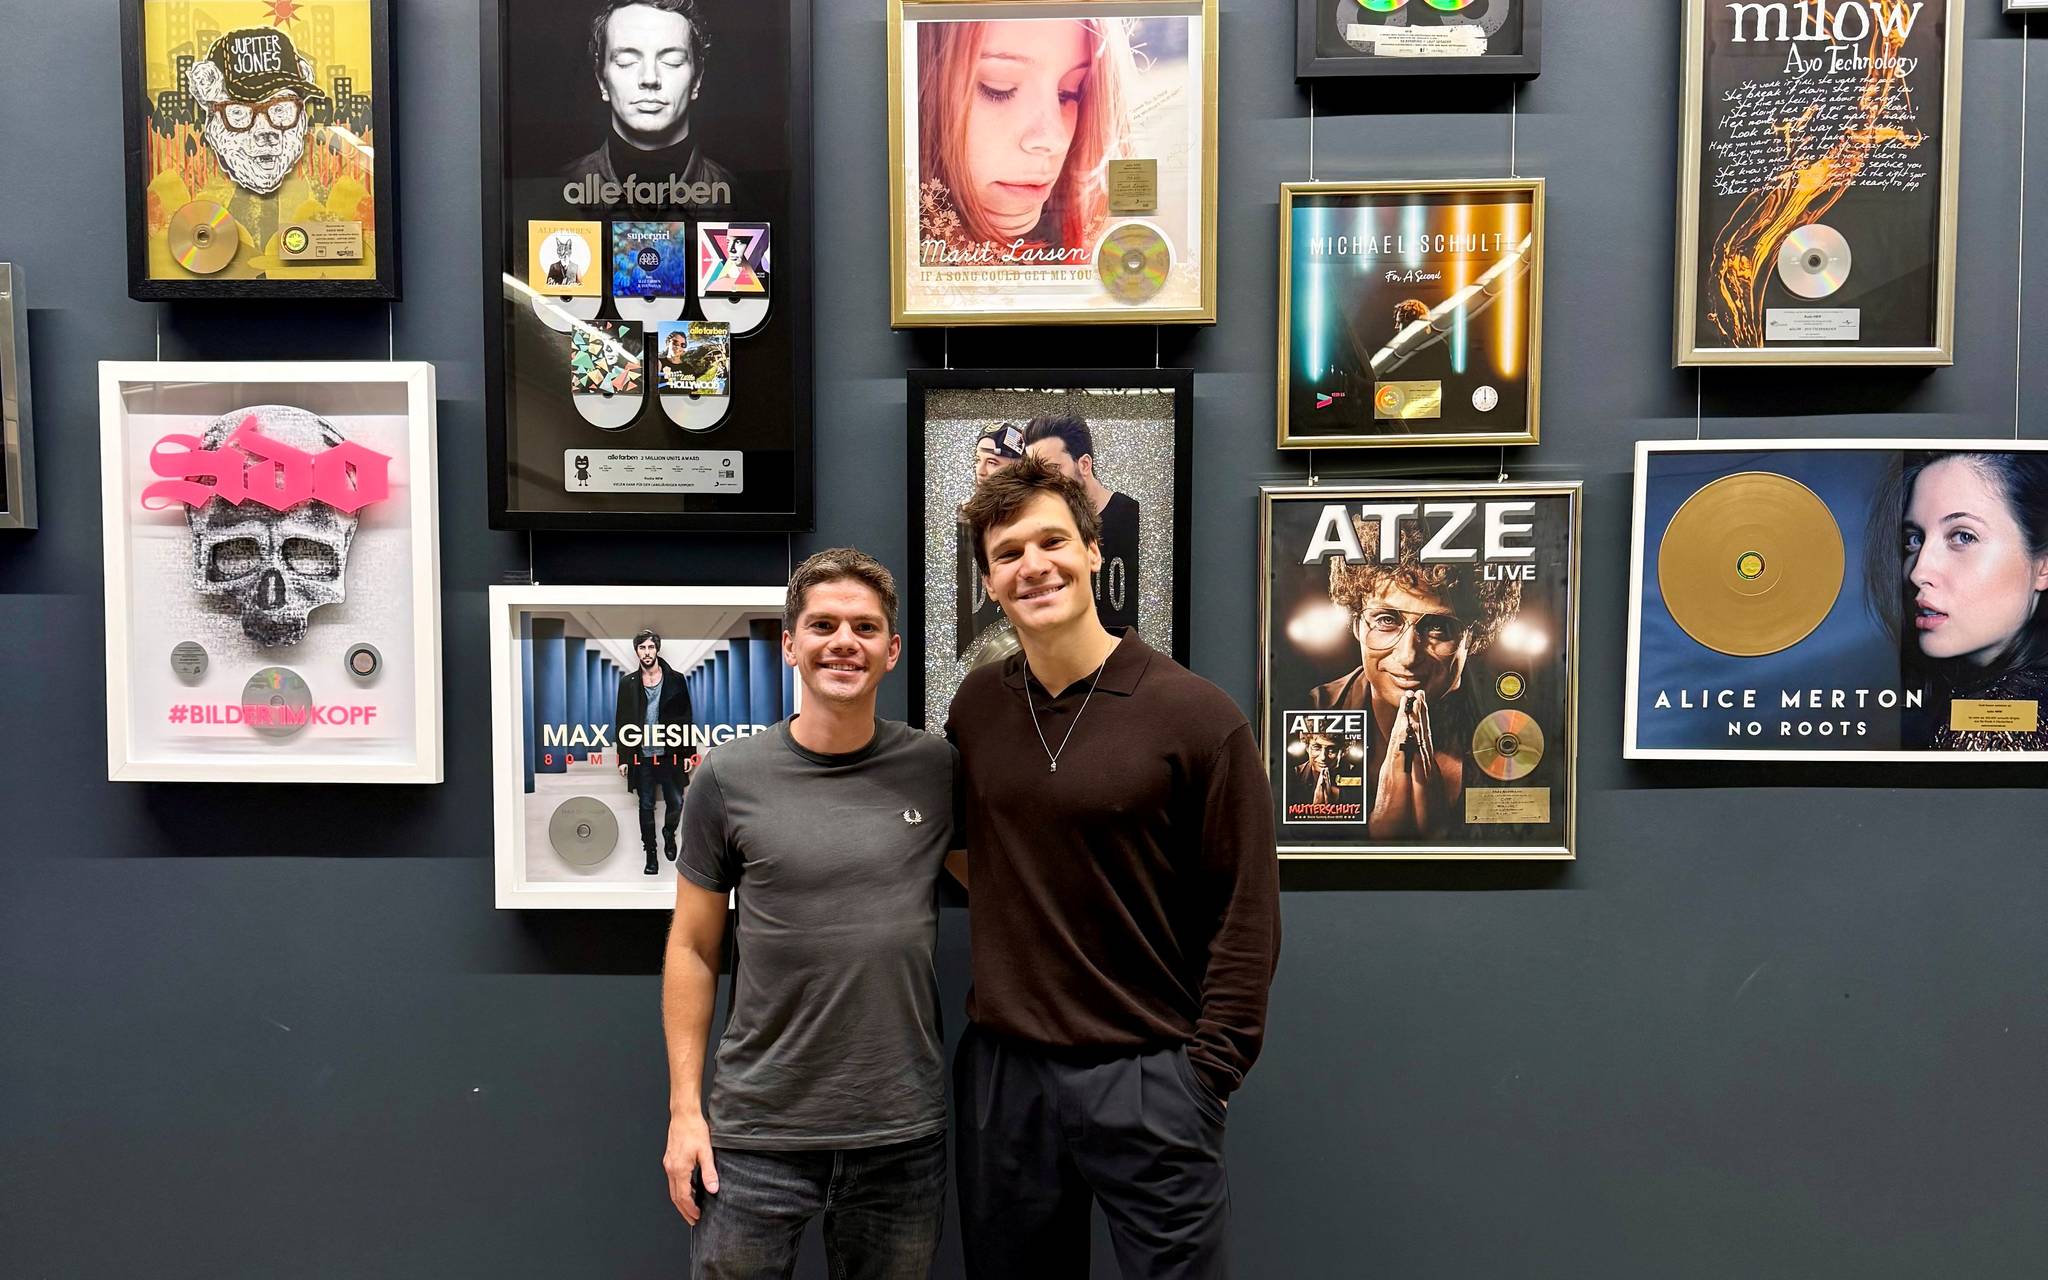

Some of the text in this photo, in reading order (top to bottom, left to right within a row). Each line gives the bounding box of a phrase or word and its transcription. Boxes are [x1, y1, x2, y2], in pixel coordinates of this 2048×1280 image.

[1726, 0, 1923, 42] milow
[231, 36, 280, 54] JUPITER
[234, 53, 280, 74] JONES
[1784, 42, 1918, 79] Ayo Technology
[626, 230, 670, 242] supergirl
[1310, 234, 1404, 256] MICHAEL
[920, 238, 1090, 264] Marit Larsen
[920, 270, 1092, 282] IF A SONG COULD GET ME YOU
[1385, 270, 1441, 284] For A Second
[670, 380, 720, 390] HOLLYWOOD
[1300, 501, 1538, 565] ATZE
[1484, 564, 1536, 580] LIVE
[1654, 689, 1923, 708] ALICE MERTON
[168, 704, 377, 726] #BILDER IM KOPF
[1290, 715, 1362, 734] ATZE
[543, 724, 611, 748] MAX
[1728, 722, 1867, 736] NO ROOTS
[544, 752, 702, 766] 80 MILLIO
[1289, 804, 1361, 814] MUTTERSCHUTZ
